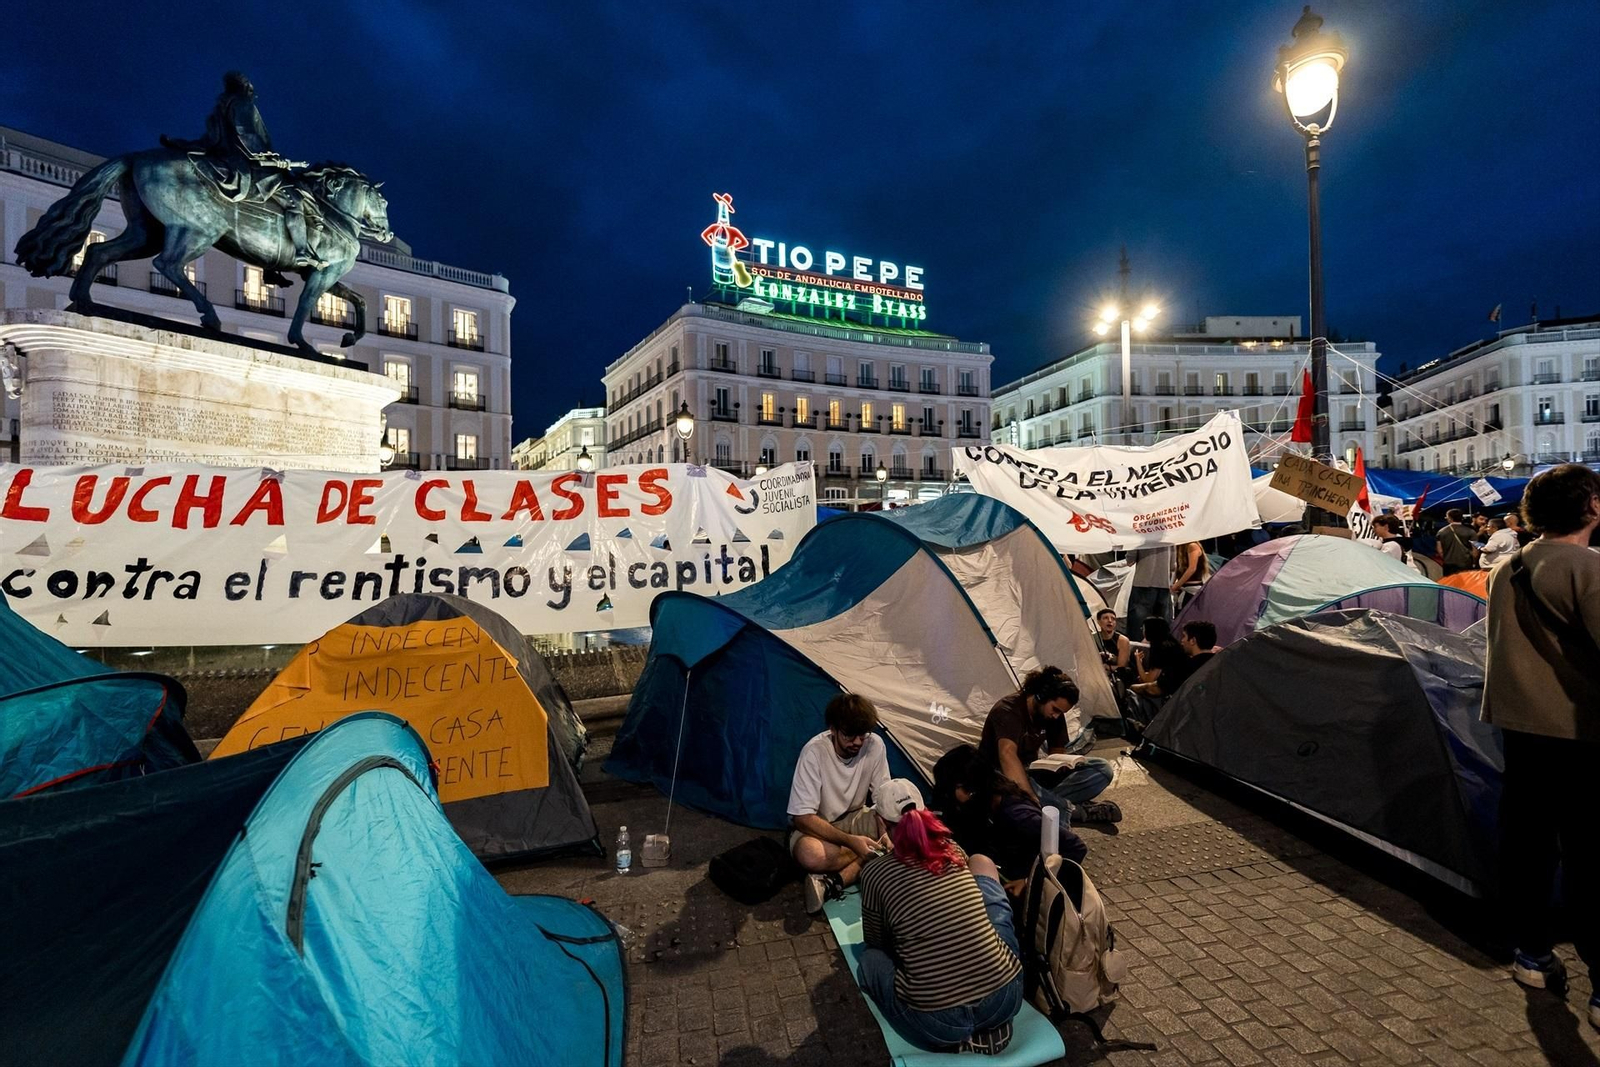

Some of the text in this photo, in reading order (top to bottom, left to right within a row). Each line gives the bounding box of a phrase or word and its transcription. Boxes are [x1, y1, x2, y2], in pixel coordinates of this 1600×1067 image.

[752, 237, 925, 290] TIO PEPE
[751, 267, 924, 302] SOL DE ANDALUCIA EMBOTELLADO
[1086, 469, 1121, 487] EL
[1283, 456, 1352, 490] CADA CASA
[1, 468, 674, 530] LUCHA DE CLASES
[762, 495, 811, 514] SOCIALISTA
[763, 488, 796, 502] JUVENIL
[1, 543, 770, 612] contra el rentismo y el capital
[351, 626, 494, 656] INDECEN
[343, 653, 518, 702] INDECENTE
[430, 708, 504, 744] CASA
[437, 746, 513, 785] ENTE
